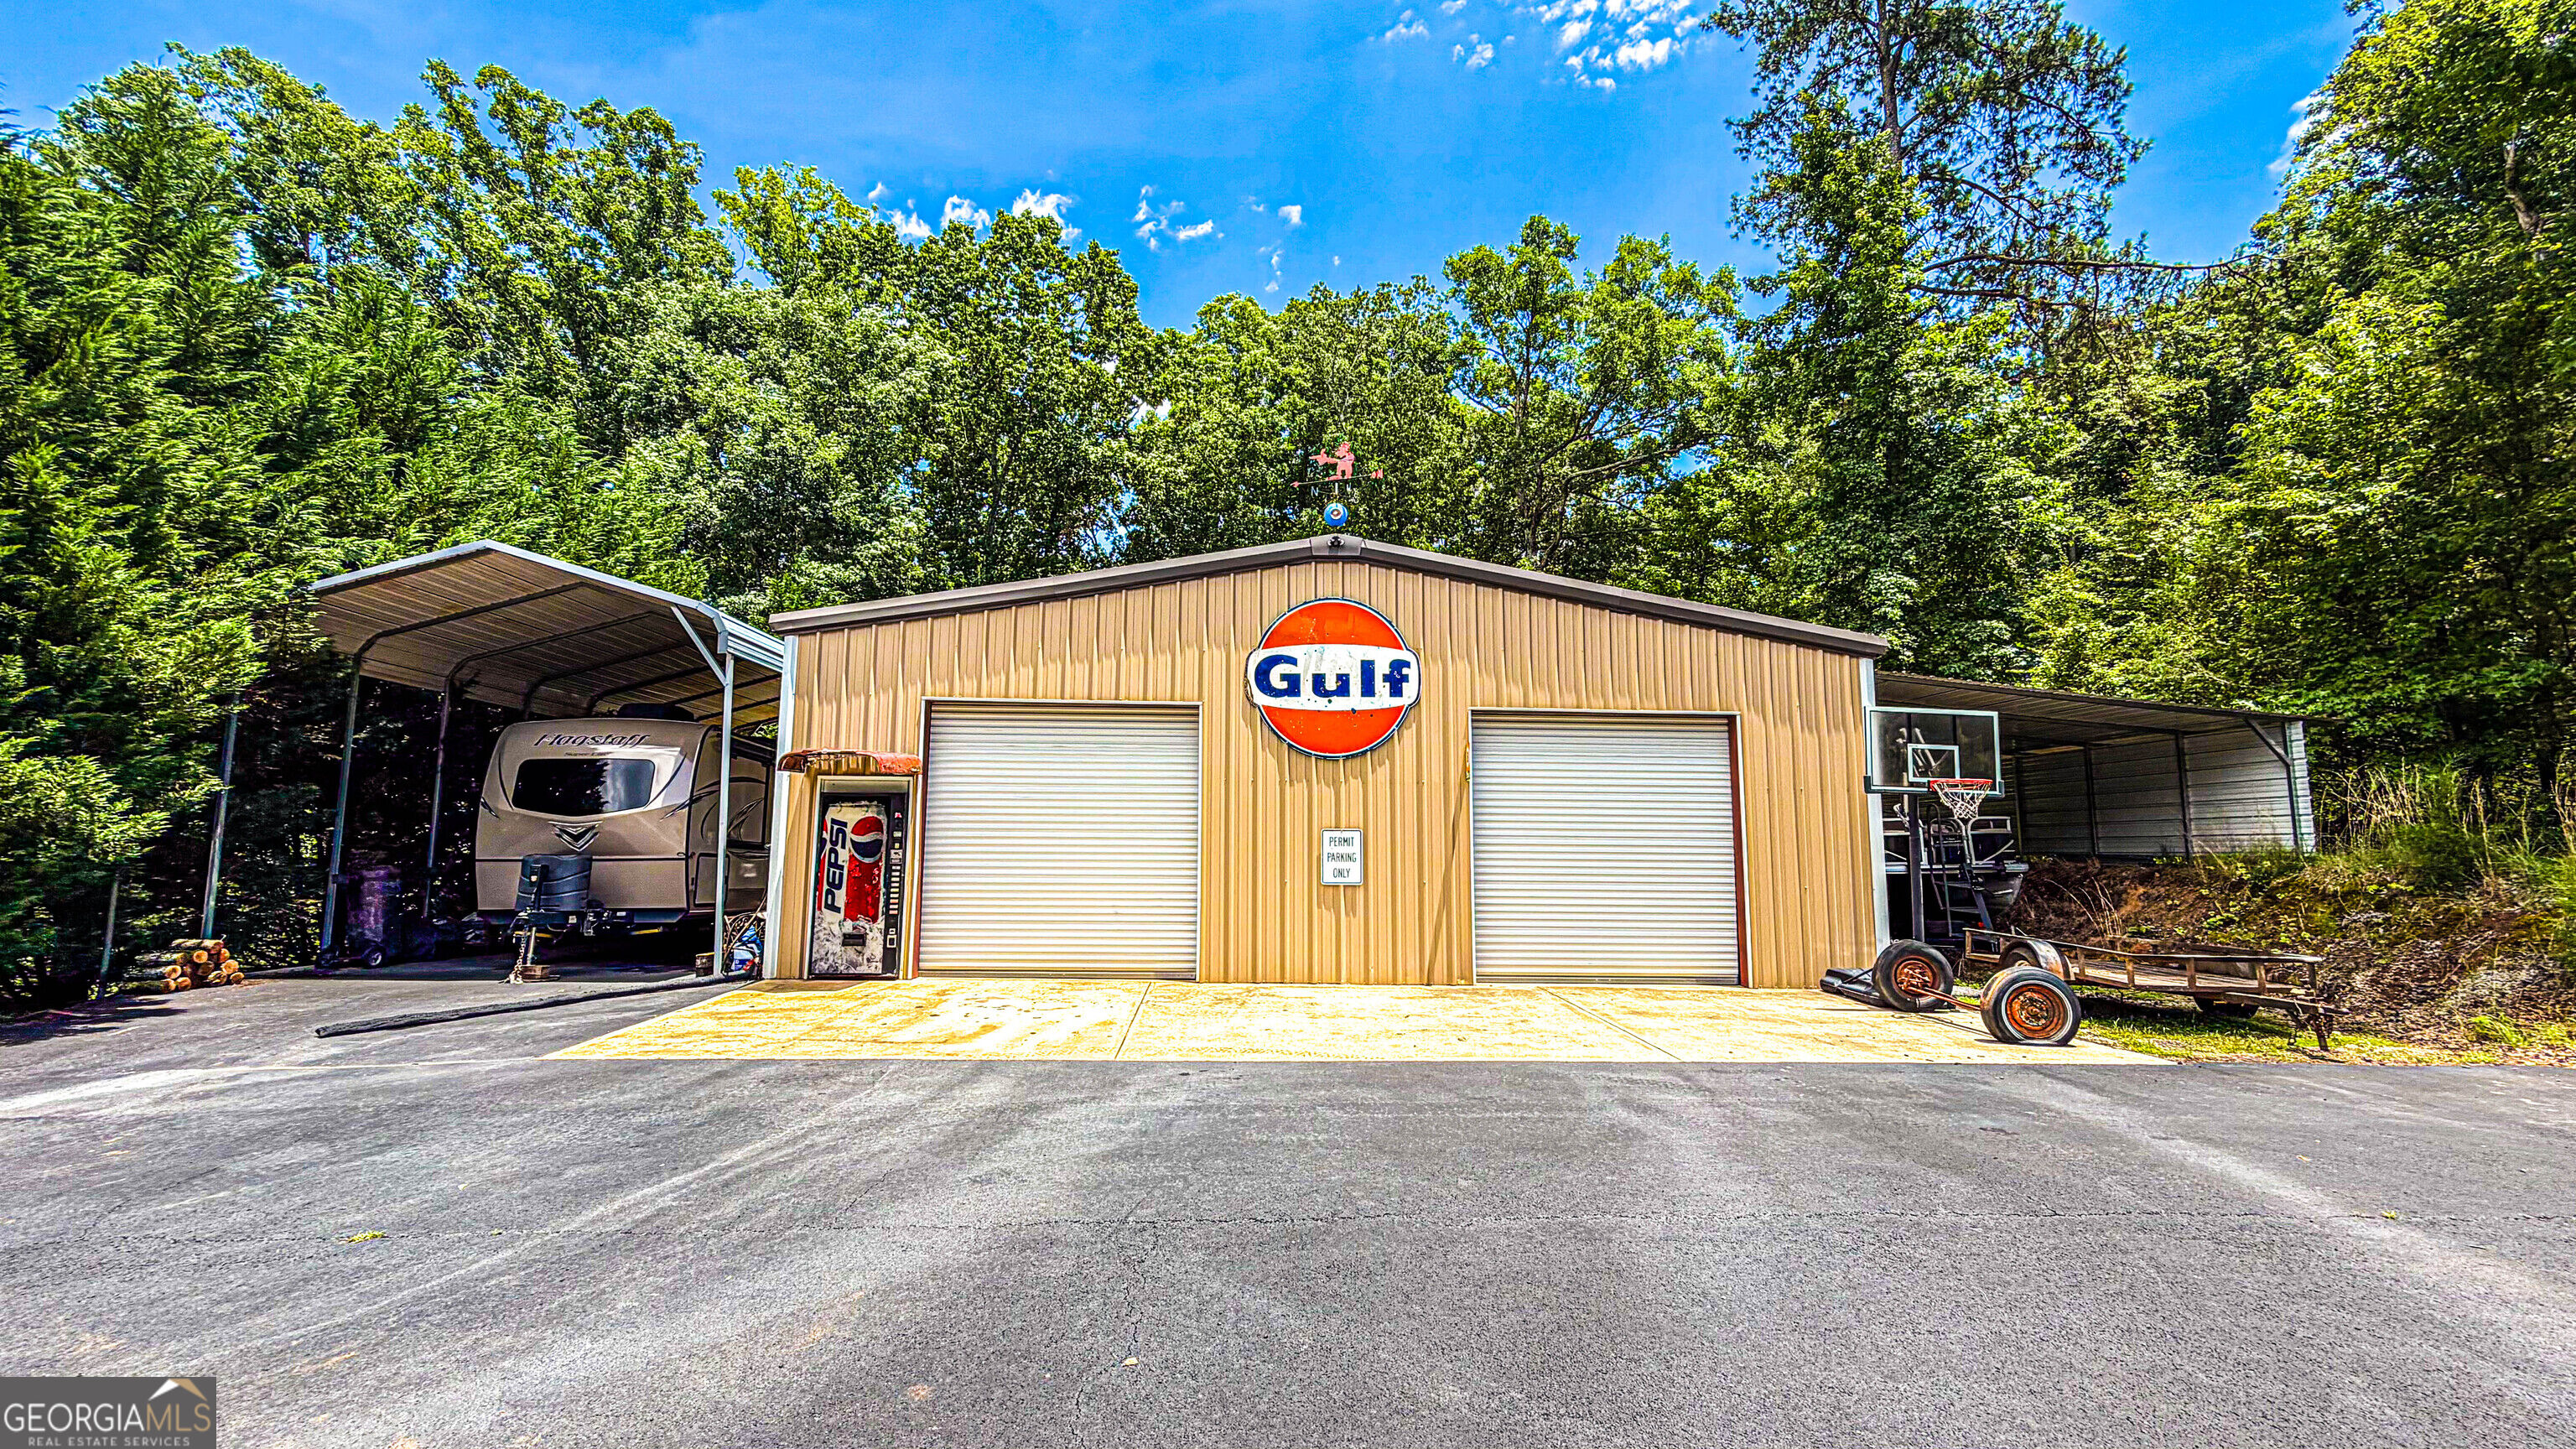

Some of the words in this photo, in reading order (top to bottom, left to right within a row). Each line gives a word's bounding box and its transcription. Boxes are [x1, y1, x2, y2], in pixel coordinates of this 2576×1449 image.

[1254, 654, 1410, 698] Gulf
[534, 734, 651, 748] Flagstaff
[1329, 836, 1354, 847] PERMIT
[1327, 852, 1357, 863] PARKING
[824, 818, 848, 913] PEPSI
[1332, 868, 1351, 879] ONLY
